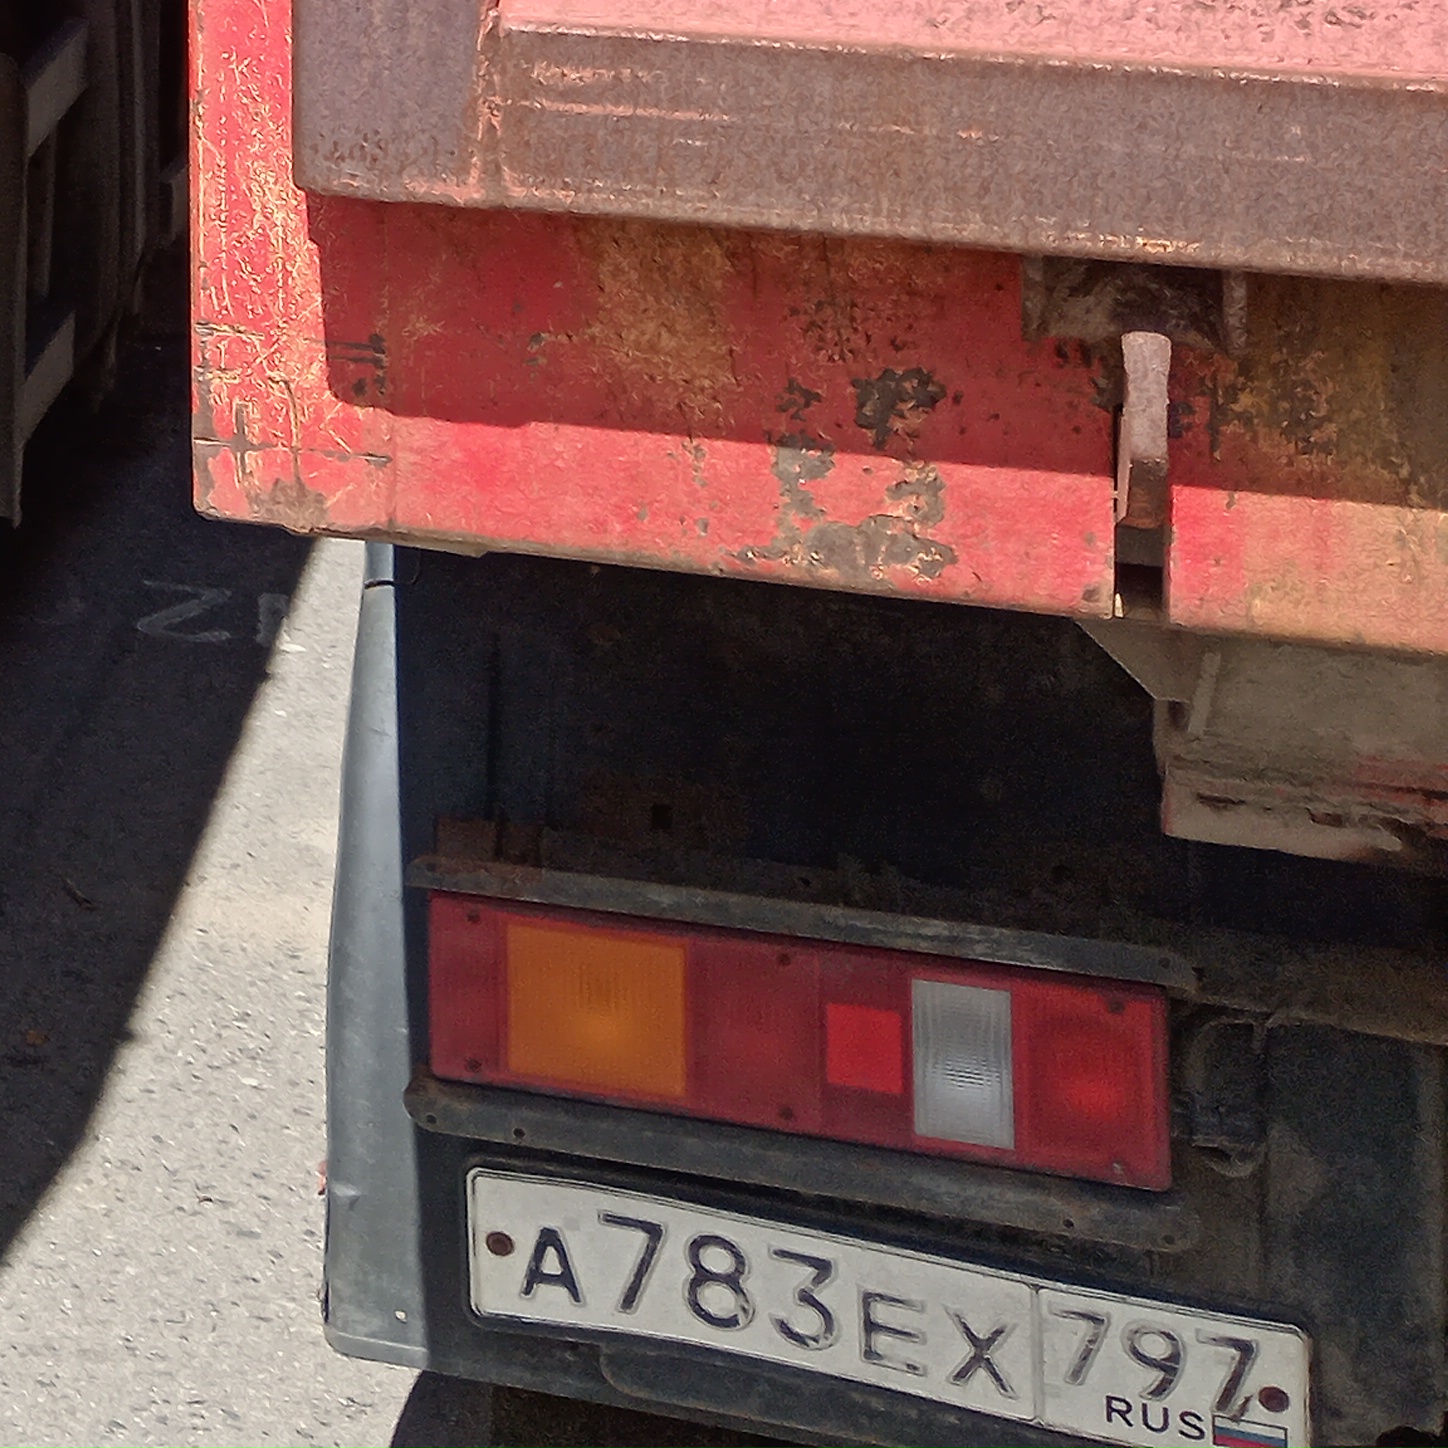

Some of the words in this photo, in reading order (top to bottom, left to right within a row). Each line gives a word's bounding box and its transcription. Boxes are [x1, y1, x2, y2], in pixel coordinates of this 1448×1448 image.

[521, 1212, 1017, 1401] А783ЕХ
[1051, 1306, 1258, 1418] 797
[1106, 1395, 1207, 1441] RUS
